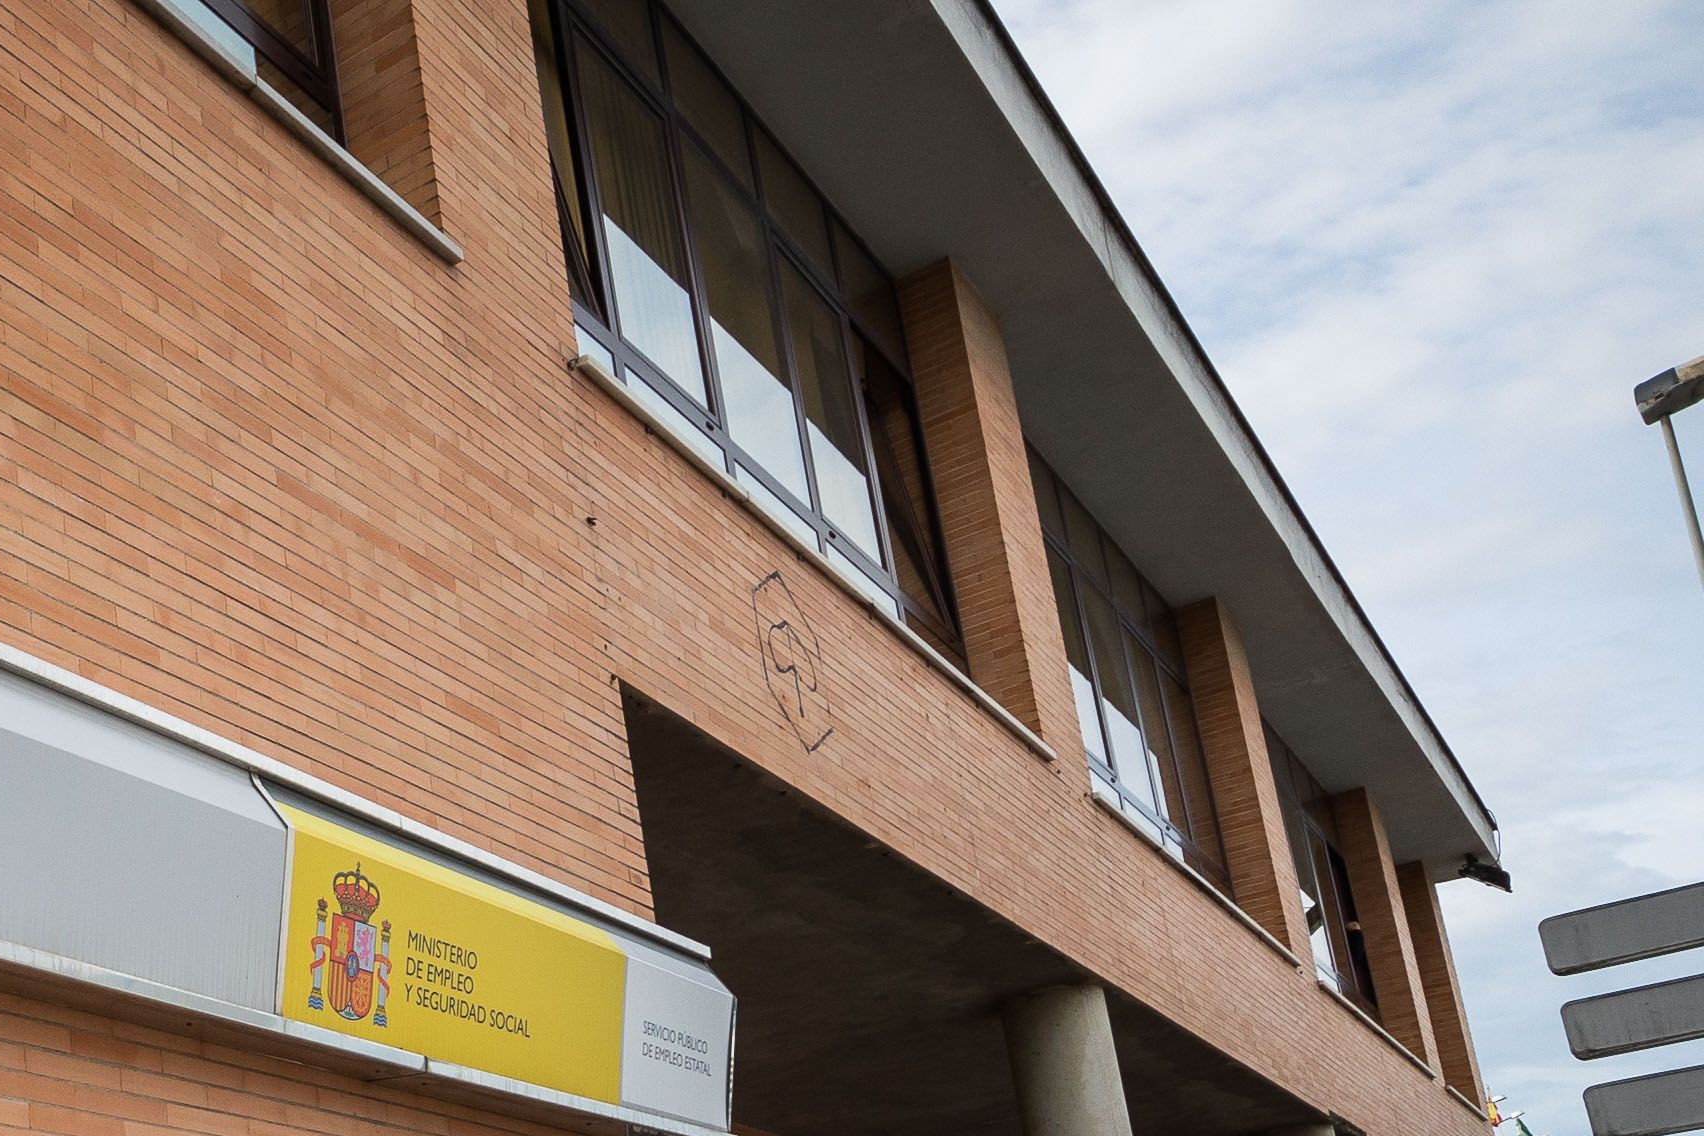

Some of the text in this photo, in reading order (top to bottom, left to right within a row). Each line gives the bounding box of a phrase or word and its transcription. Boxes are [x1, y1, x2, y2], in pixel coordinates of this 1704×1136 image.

[407, 931, 478, 970] MINISTERIO
[406, 957, 474, 995] DE EMPLEO
[405, 983, 531, 1038] Y SEGURIDAD SOCIAL
[643, 1020, 708, 1055] SERVICIO PÚBLICO
[642, 1042, 712, 1077] DE EMPLEO ESTATAL
